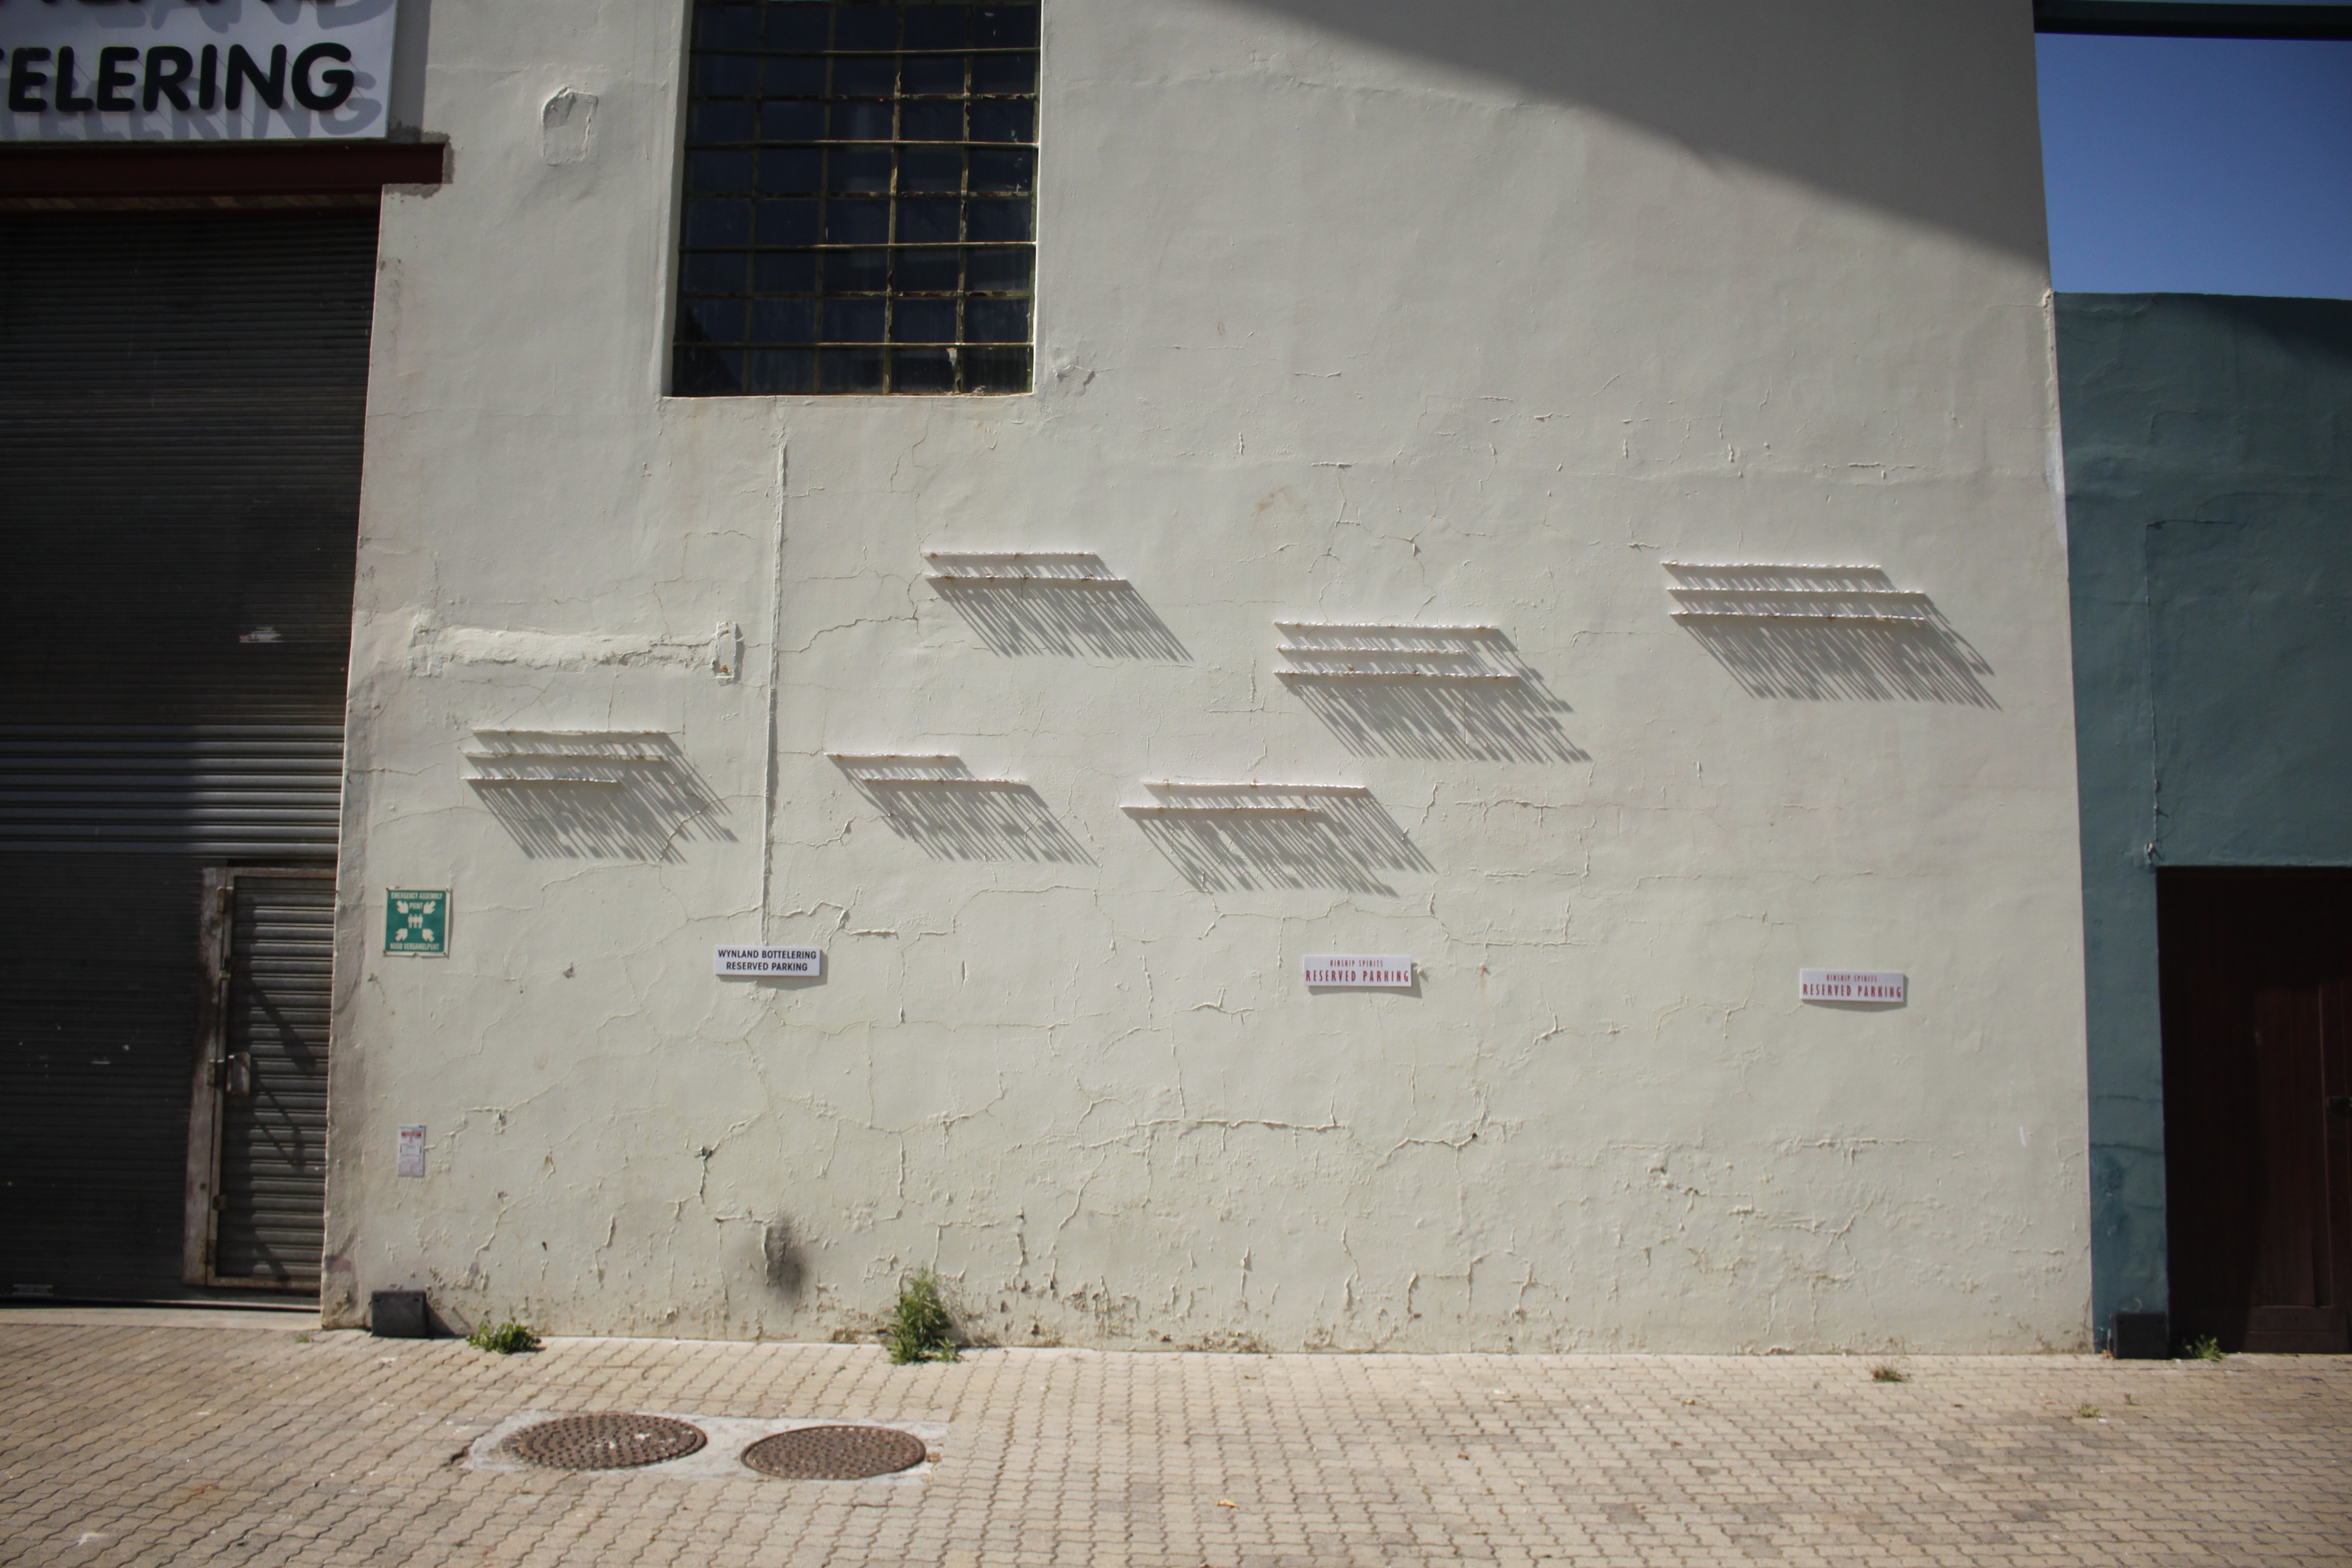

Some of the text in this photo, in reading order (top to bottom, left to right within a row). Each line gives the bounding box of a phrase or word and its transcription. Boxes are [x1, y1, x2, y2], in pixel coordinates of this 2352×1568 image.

[0, 43, 354, 112] ELERING
[718, 949, 817, 959] WYNLAND BOTTELERING
[726, 962, 808, 971] RESERVED PARKING
[1306, 970, 1409, 982] RESERVED PARKING
[1803, 983, 1901, 998] RESERVED PARKING
